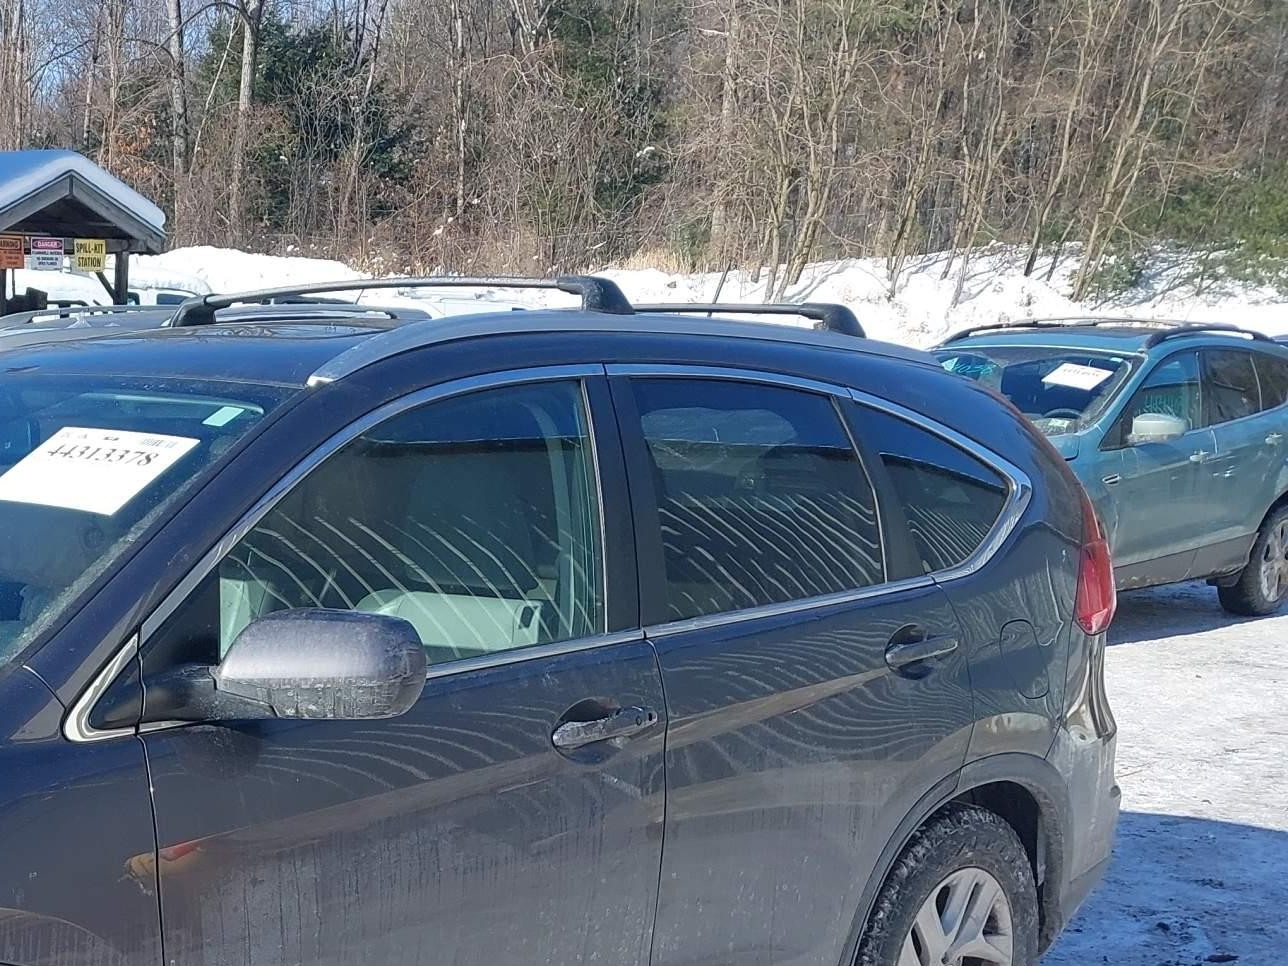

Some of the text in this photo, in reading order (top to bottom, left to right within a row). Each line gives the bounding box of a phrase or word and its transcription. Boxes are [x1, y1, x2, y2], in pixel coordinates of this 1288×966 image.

[37, 240, 58, 248] DANGER
[76, 243, 104, 254] SPILL-KIT
[78, 256, 101, 267] STATION
[47, 444, 160, 466] 44313378
